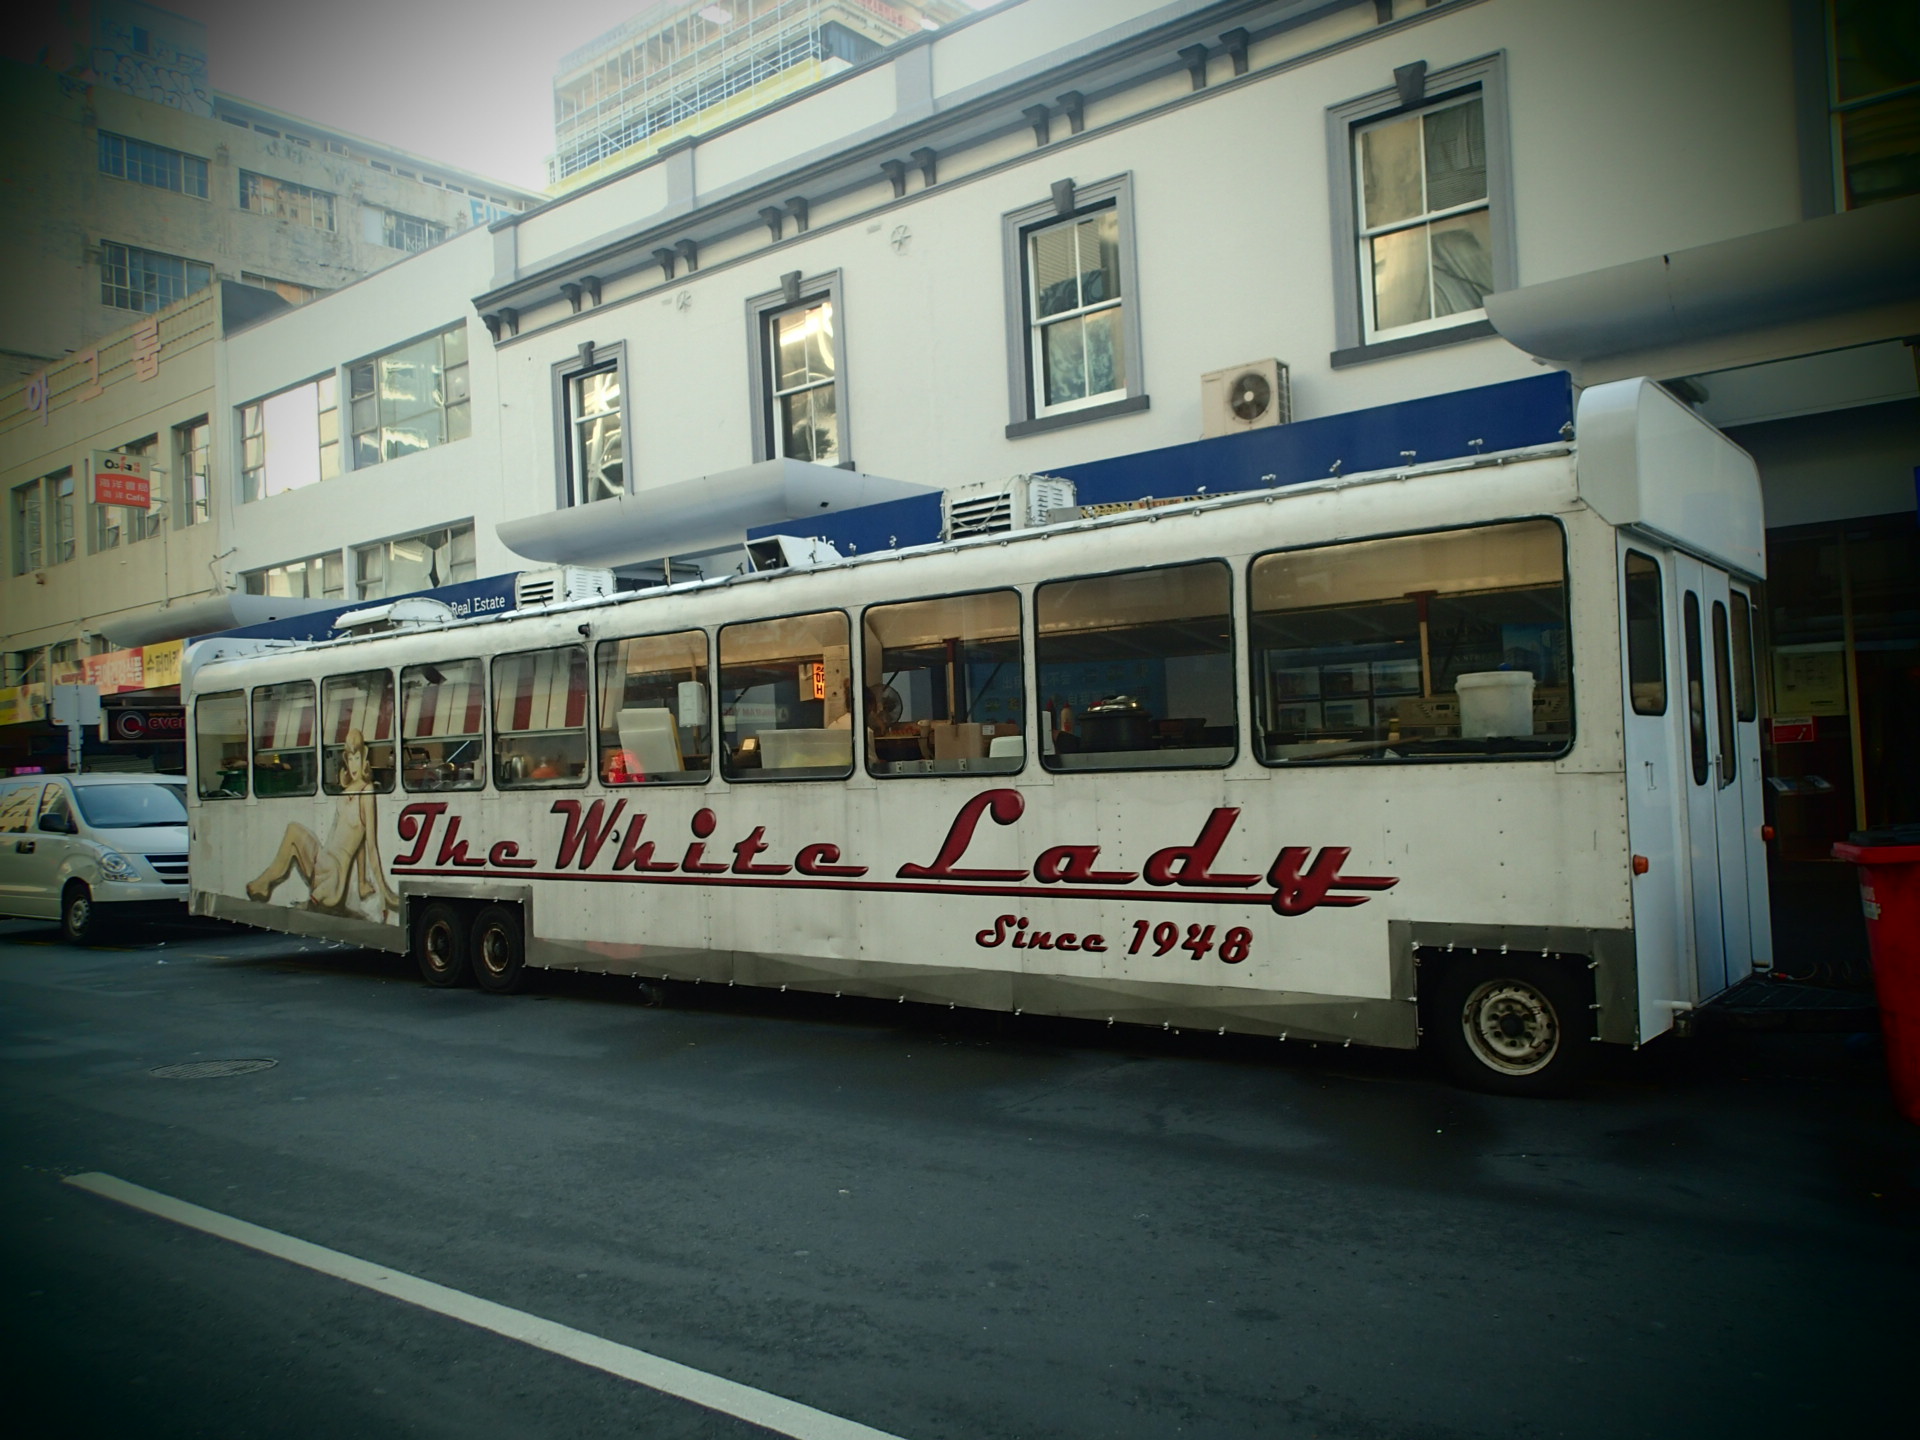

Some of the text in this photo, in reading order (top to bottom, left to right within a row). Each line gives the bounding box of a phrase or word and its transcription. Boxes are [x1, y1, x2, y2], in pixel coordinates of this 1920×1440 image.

[451, 595, 506, 616] Real Estate
[392, 788, 1400, 917] The White Lady
[975, 914, 1255, 964] Since 1948
